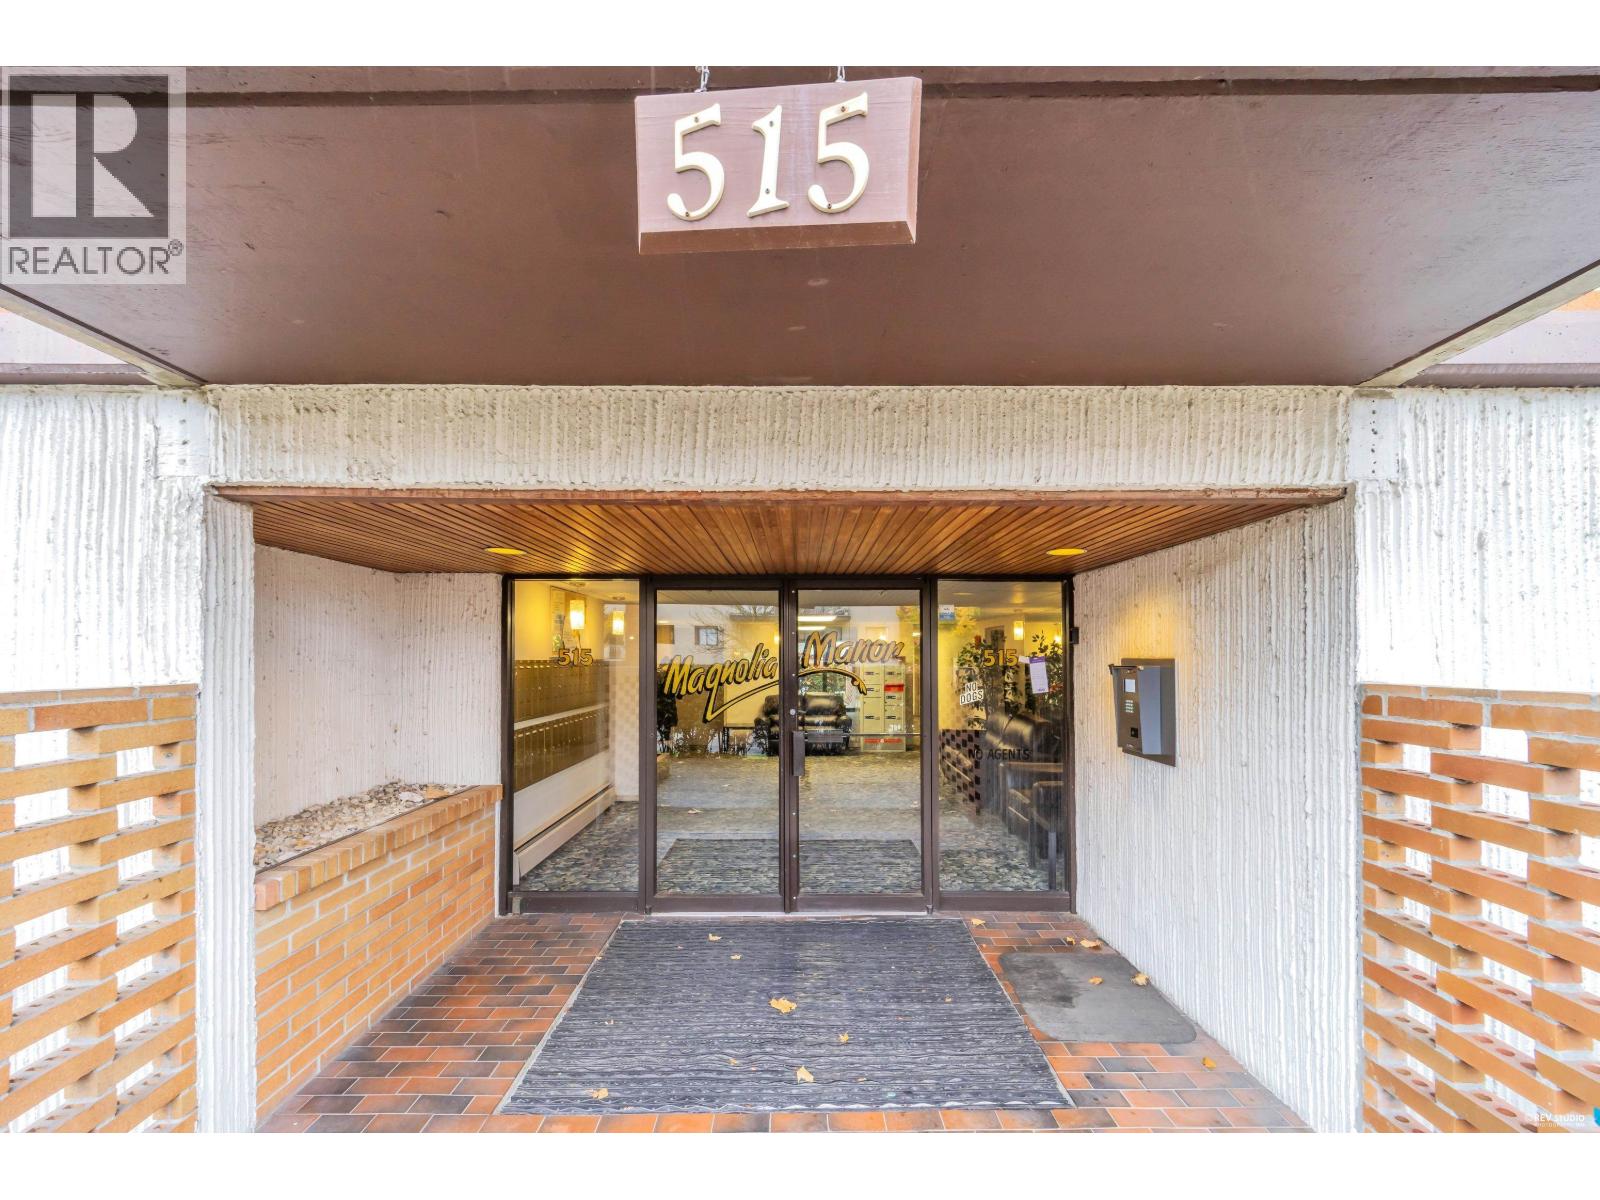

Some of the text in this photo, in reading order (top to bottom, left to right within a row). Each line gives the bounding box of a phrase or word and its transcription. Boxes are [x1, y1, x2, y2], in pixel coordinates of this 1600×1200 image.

[666, 91, 870, 222] 515
[558, 648, 593, 667] 515
[983, 649, 1019, 667] 515
[663, 631, 905, 723] Magnolia Manor
[965, 682, 977, 692] NO
[960, 690, 983, 705] DOGS
[968, 748, 1031, 761] NO AGENTS
